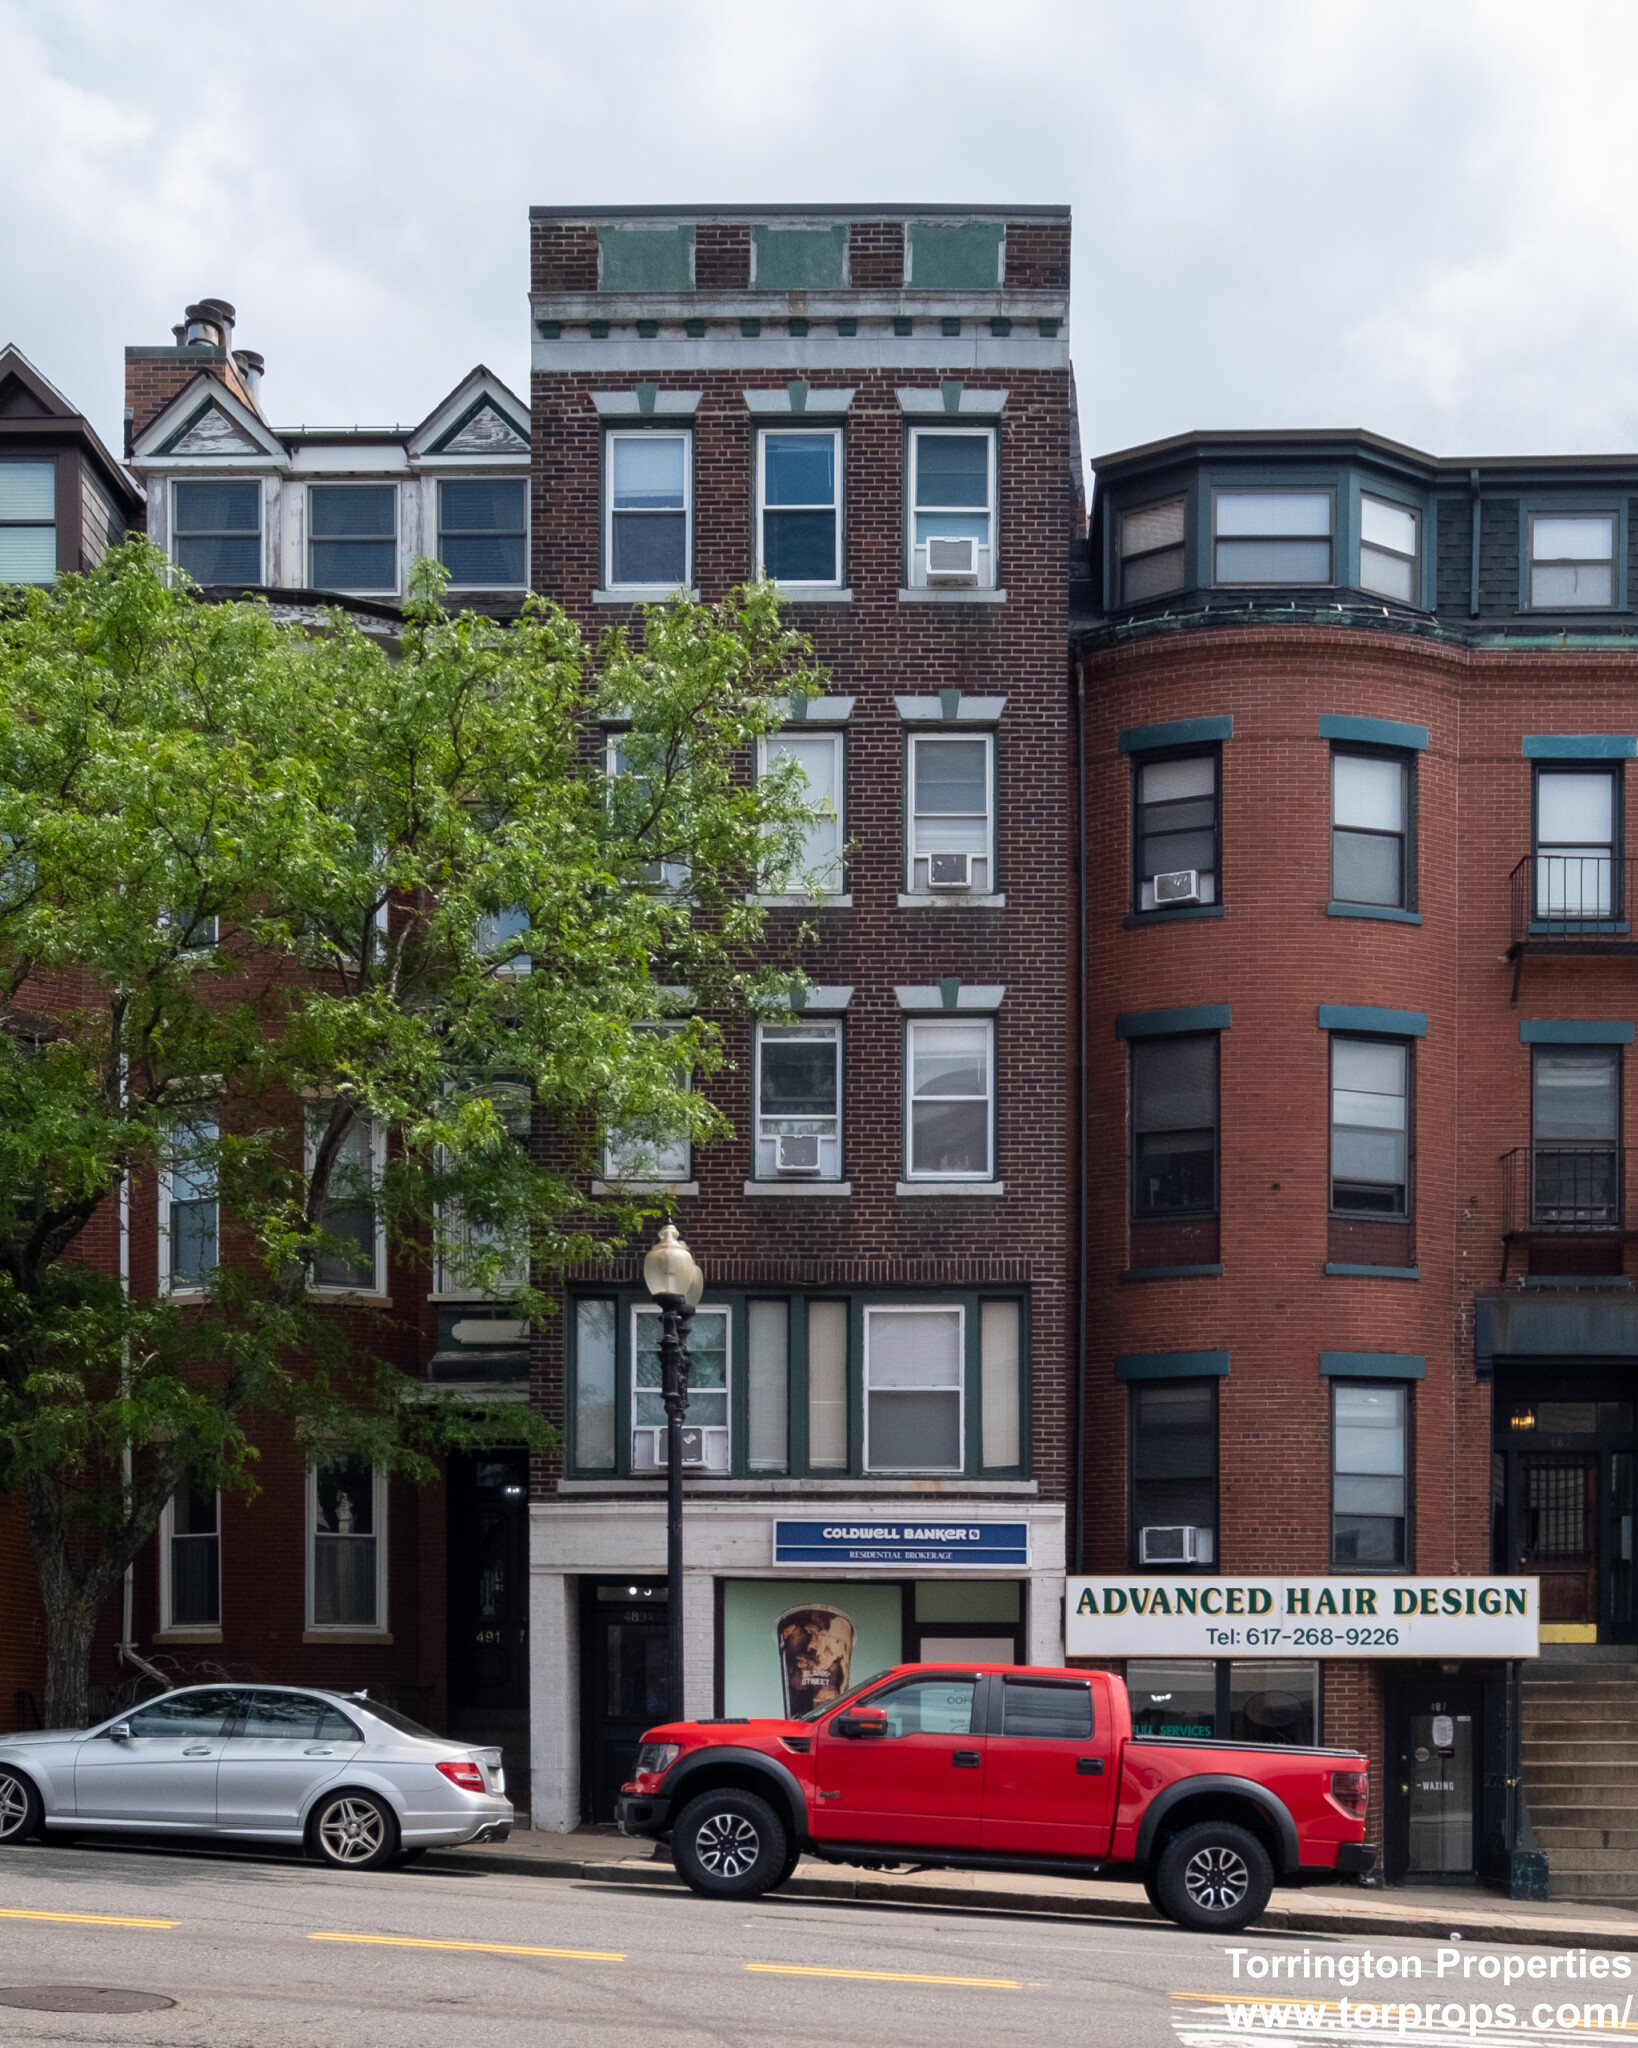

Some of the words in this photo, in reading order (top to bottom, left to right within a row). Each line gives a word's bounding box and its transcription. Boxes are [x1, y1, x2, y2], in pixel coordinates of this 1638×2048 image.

[822, 1527, 900, 1540] COLDWELL
[903, 1528, 967, 1541] BANKER
[849, 1550, 902, 1560] RESIDENTIAL
[904, 1551, 953, 1560] BROKERAGE
[1076, 1586, 1275, 1616] ADVANCED
[1286, 1587, 1379, 1616] HAIR
[1393, 1587, 1530, 1617] DESIGN
[475, 1631, 501, 1644] 491
[1206, 1627, 1242, 1646] Tel:
[1246, 1627, 1400, 1646] 617-268-9226
[1160, 1725, 1212, 1737] SERVICES
